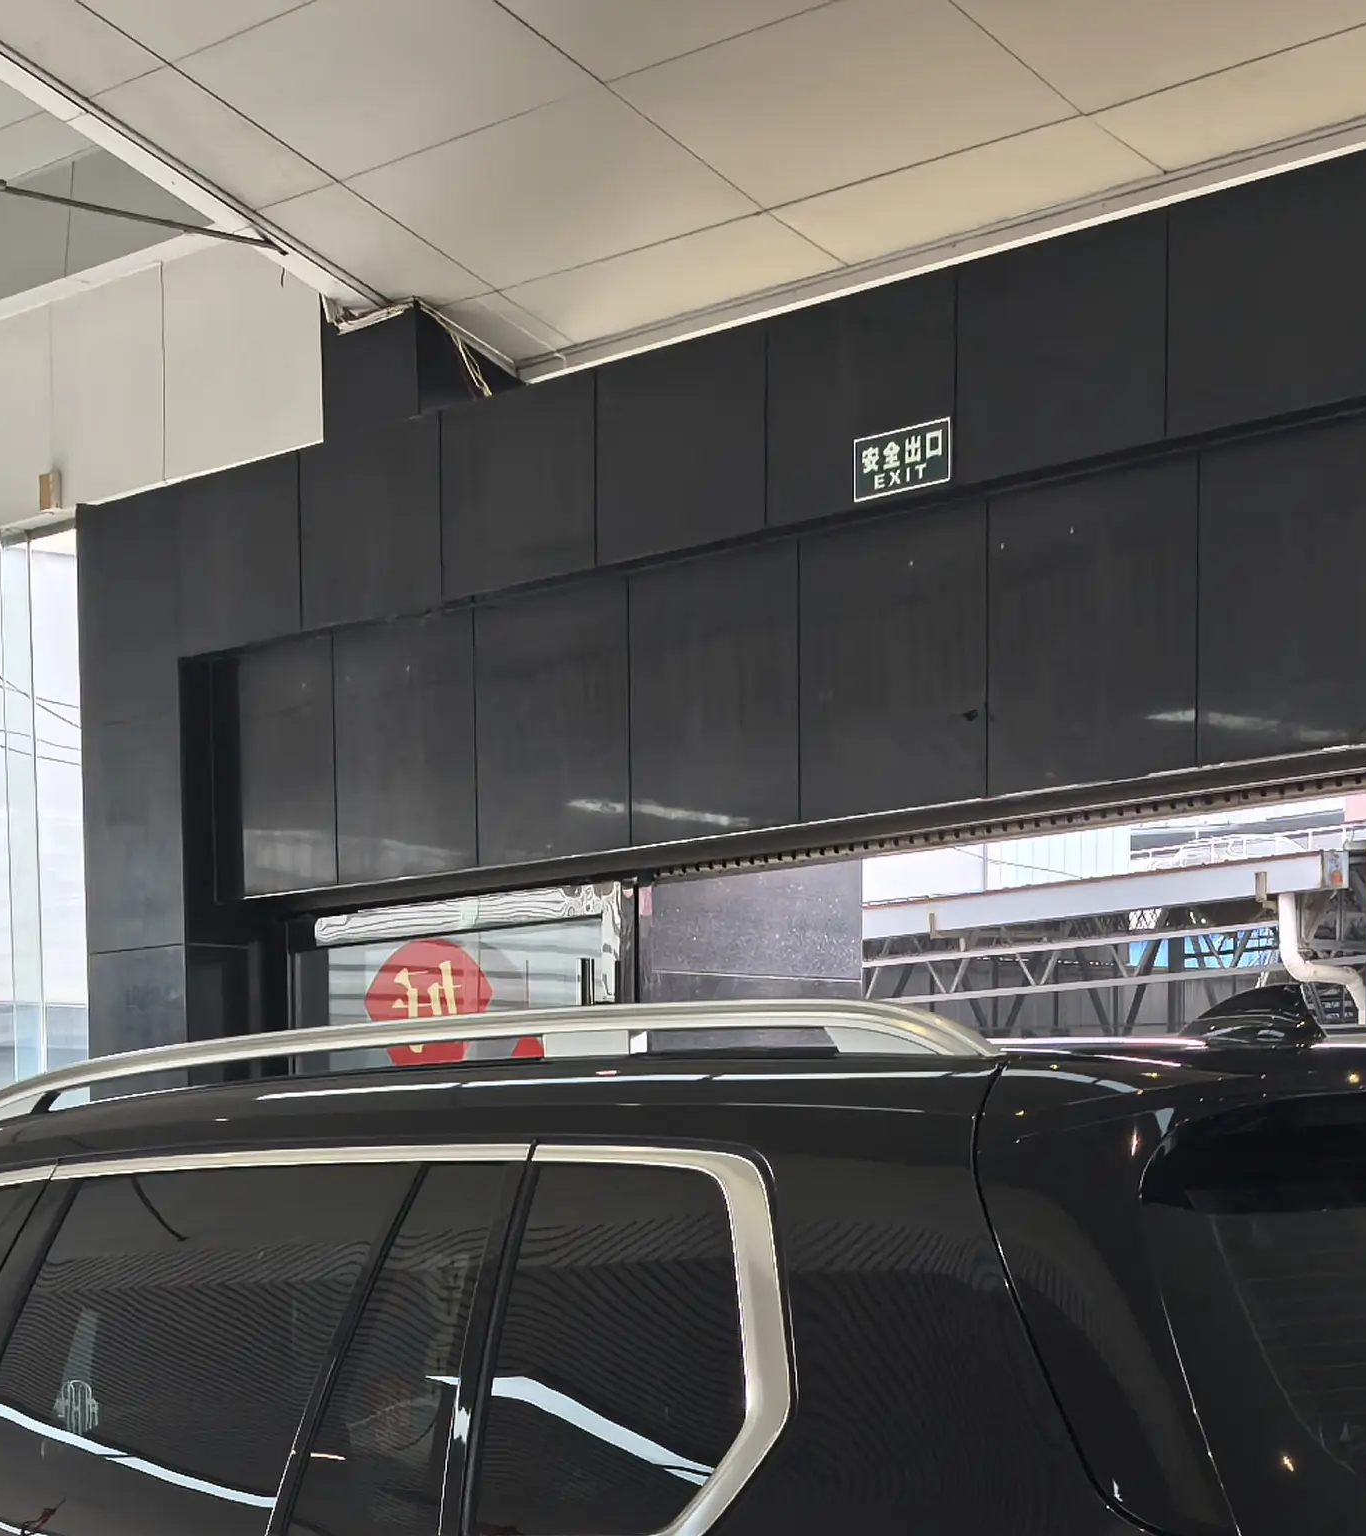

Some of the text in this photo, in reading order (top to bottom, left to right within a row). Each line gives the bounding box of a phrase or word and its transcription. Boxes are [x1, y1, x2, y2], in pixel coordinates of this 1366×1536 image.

[862, 429, 942, 473] 安全出口
[875, 462, 927, 489] EXIT
